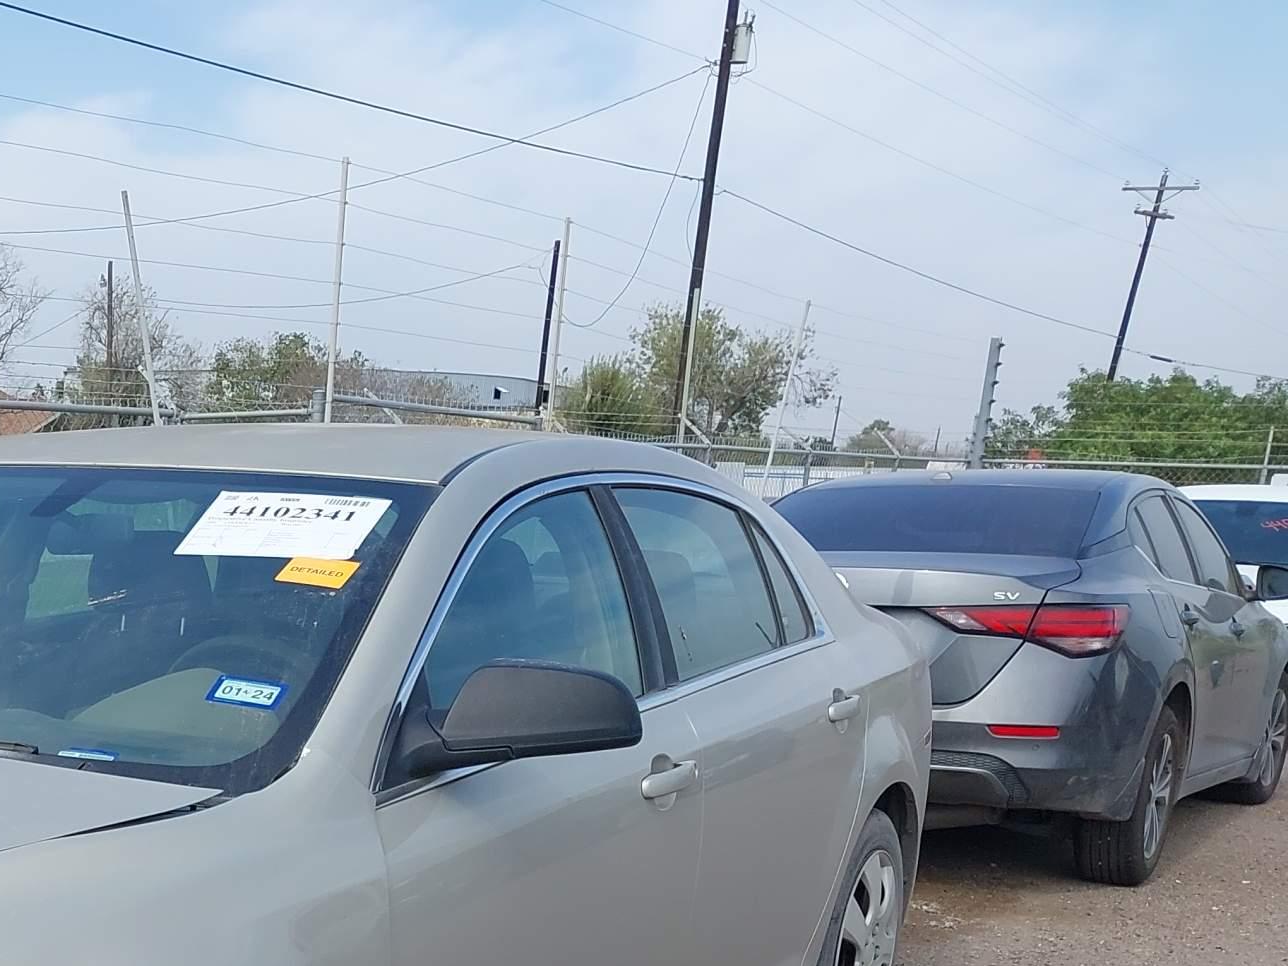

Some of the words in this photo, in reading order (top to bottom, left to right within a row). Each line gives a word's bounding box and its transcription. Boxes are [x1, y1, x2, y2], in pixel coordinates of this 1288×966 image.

[223, 505, 357, 522] 44102341
[290, 566, 344, 577] DETAILED
[993, 591, 1020, 600] SV
